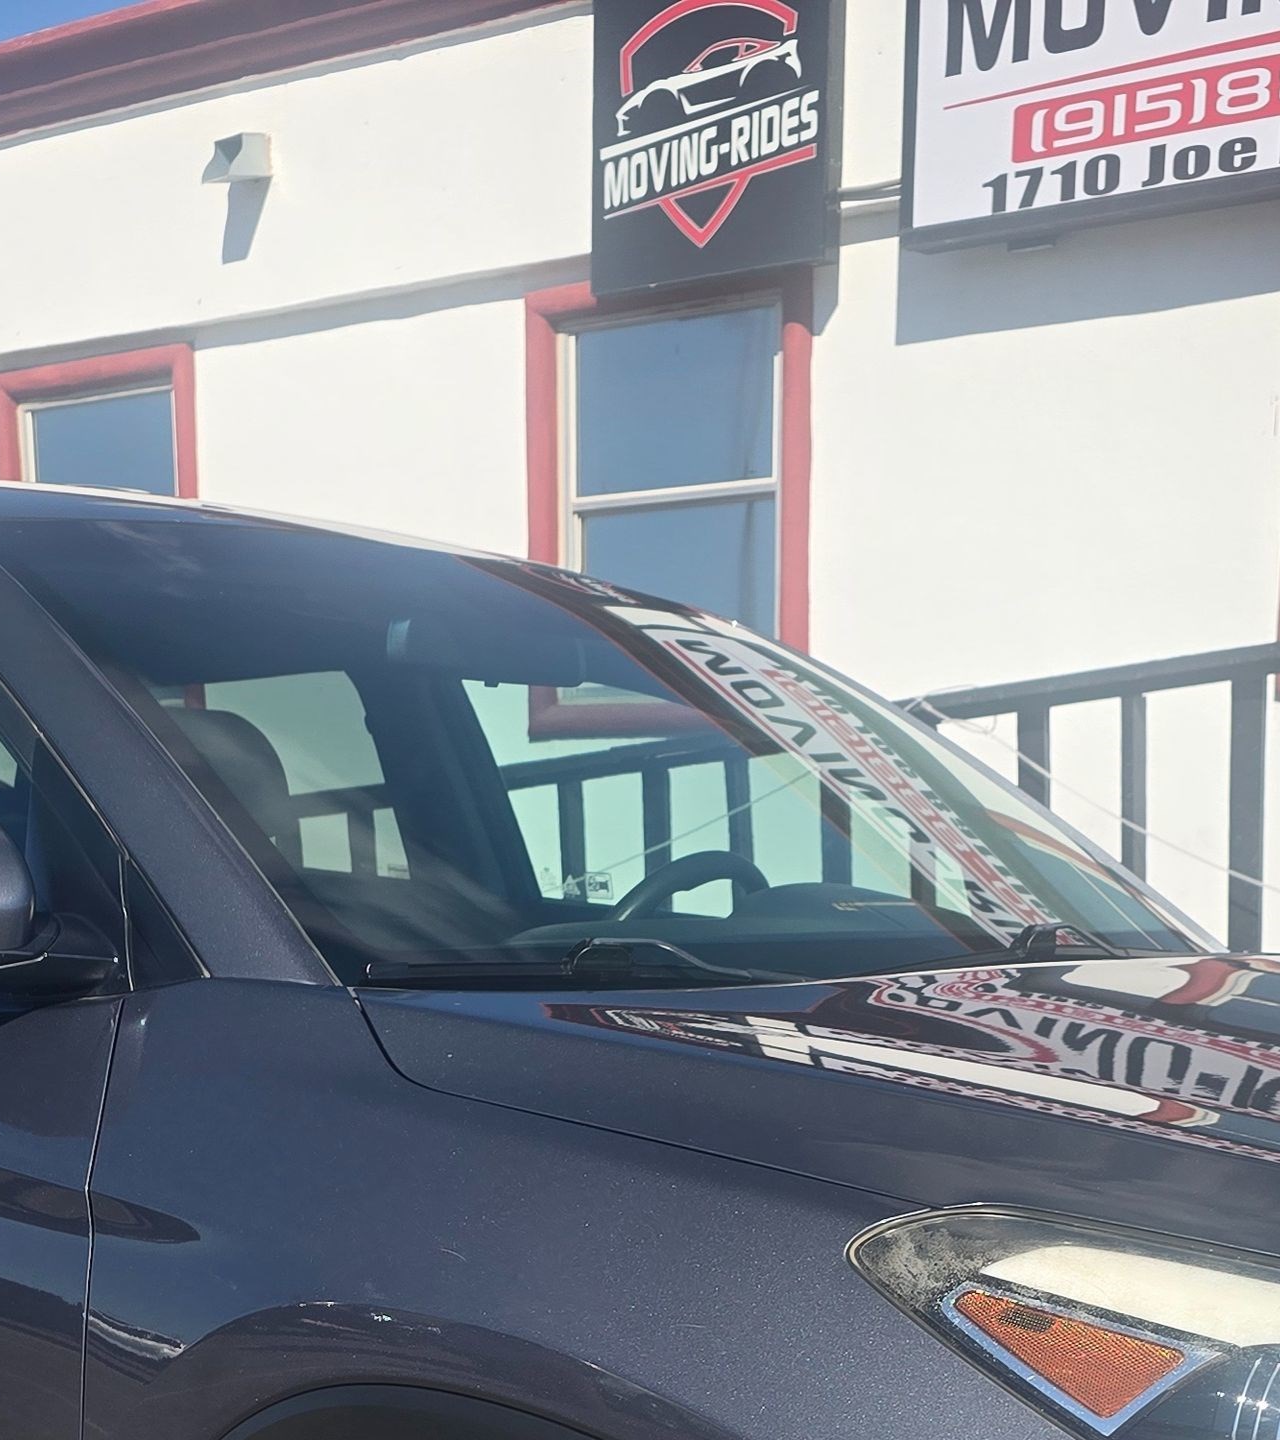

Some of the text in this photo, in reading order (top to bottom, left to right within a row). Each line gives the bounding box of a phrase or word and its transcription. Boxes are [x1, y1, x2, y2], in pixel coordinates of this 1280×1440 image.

[603, 90, 820, 210] MOVING-RIDES
[982, 153, 1121, 214] 1710
[1141, 137, 1258, 188] Joe
